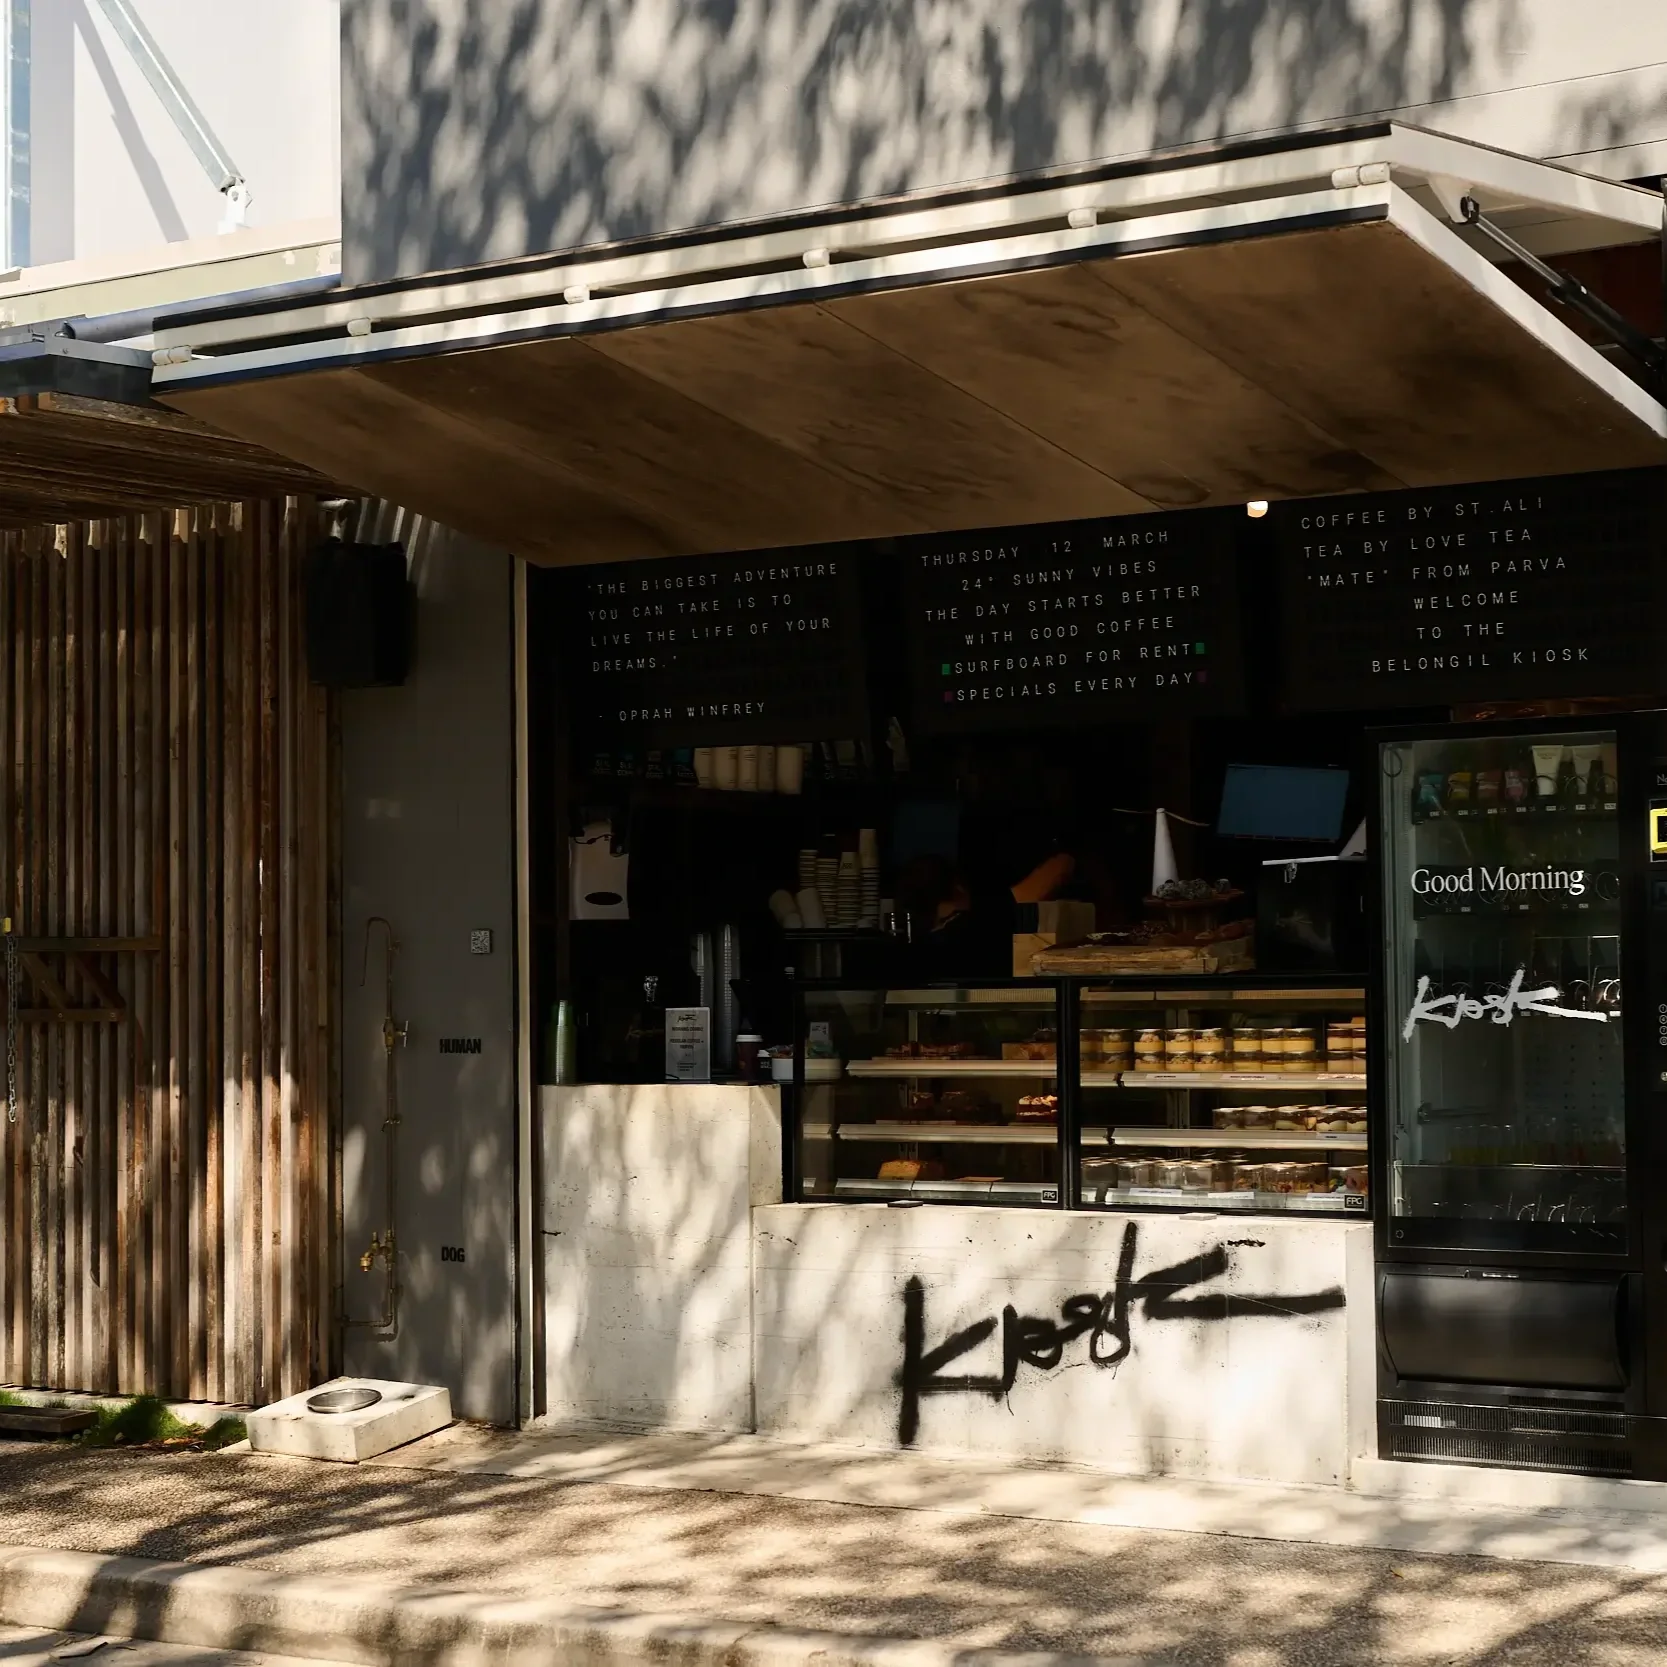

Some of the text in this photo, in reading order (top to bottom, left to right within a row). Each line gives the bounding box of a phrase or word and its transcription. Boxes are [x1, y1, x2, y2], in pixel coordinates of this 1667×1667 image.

[1301, 510, 1385, 530] COFFEE
[1408, 506, 1433, 520] BY
[921, 530, 1168, 567] THURSDAY 12 MARCH
[1303, 528, 1531, 558] TEA BY LOVE TEA
[641, 573, 717, 591] BIGGEST
[733, 563, 837, 583] ADVENTURE
[1013, 568, 1074, 586] SUNNY
[1092, 560, 1156, 578] VIBES
[1412, 563, 1470, 580] FROM
[1491, 556, 1566, 574] PARVA
[588, 594, 791, 621] YOU CAN TAKE IS TO
[925, 585, 1200, 621] THE DAY STARTS BETTER
[1413, 590, 1518, 610] WELCOME
[591, 617, 830, 647] LIVE THE LIFE OF YOUR
[965, 616, 1174, 646] WITH GOOD COFFEE
[1416, 622, 1504, 640] TO THE
[955, 643, 1190, 674] SURFBOARD FOR RENT
[1372, 648, 1588, 673] BELONGIL KIOSK
[957, 672, 1192, 701] SPECIALS EVERY DAY
[619, 708, 672, 722] OPRAH
[687, 702, 764, 717] WINFREY
[1411, 865, 1585, 895] Good Morning
[440, 1038, 481, 1054] HUMAN
[1346, 1197, 1362, 1205] FPG
[441, 1246, 465, 1263] DOG
